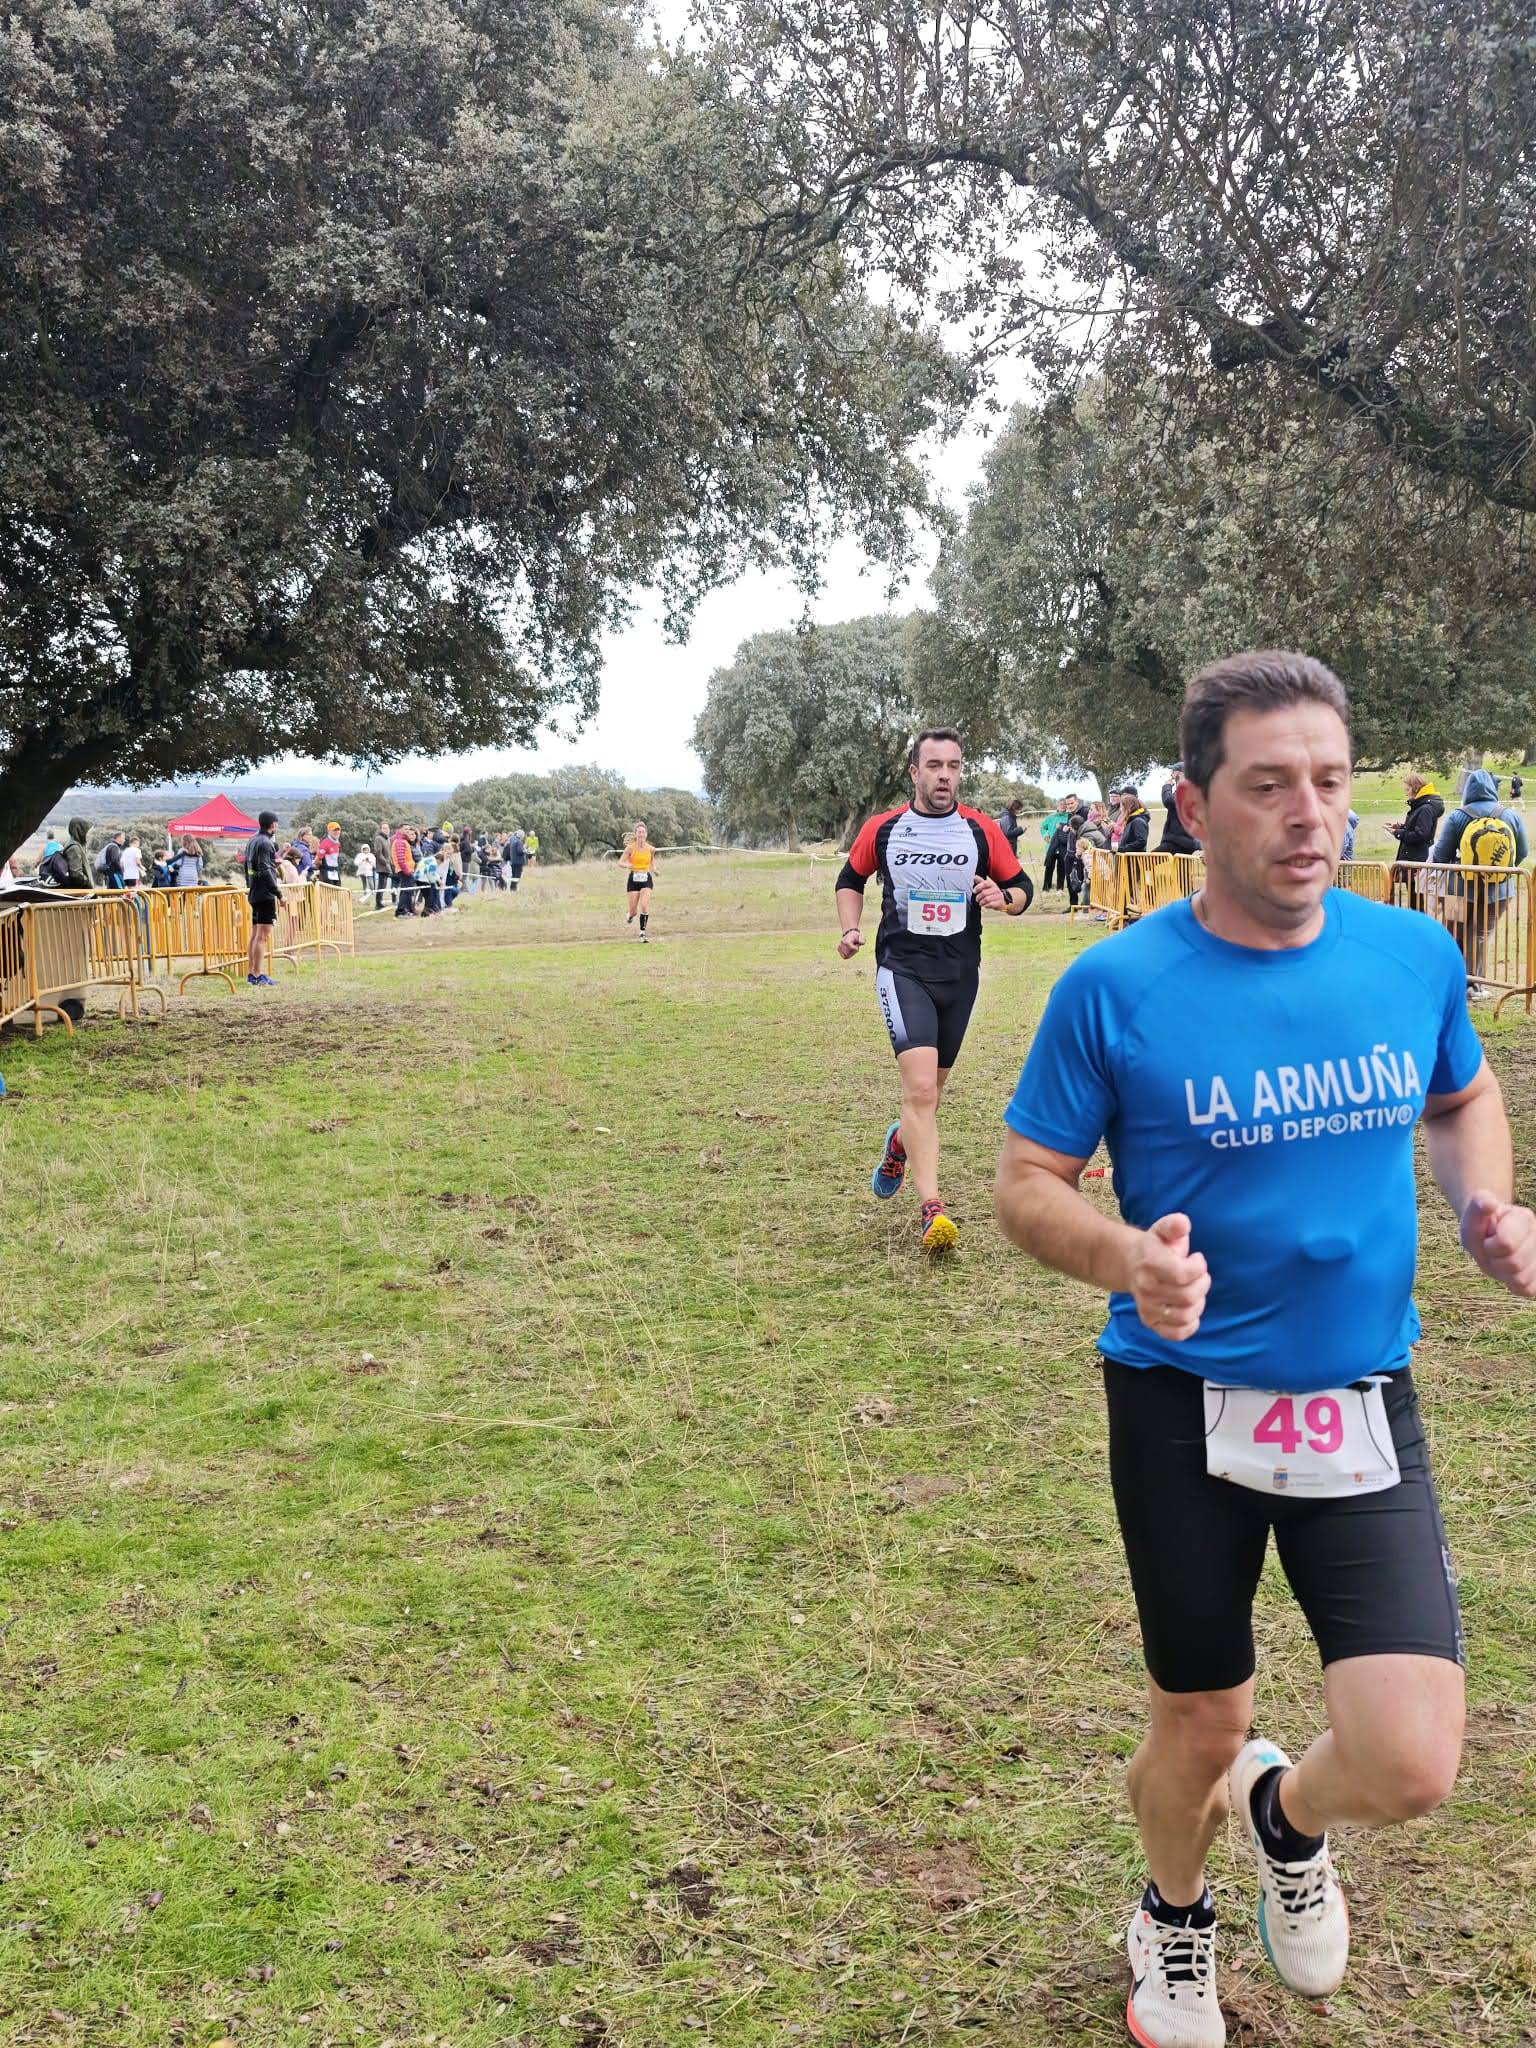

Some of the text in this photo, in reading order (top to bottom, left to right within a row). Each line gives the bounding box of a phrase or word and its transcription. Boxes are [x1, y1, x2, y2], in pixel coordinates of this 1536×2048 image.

[894, 853, 969, 866] 37300
[922, 903, 951, 922] 59
[880, 987, 897, 1042] 37300
[1184, 1042, 1422, 1126] LA ARMUÑA
[1210, 1103, 1414, 1149] CLUB DEPORTIVO
[1253, 1396, 1344, 1454] 49
